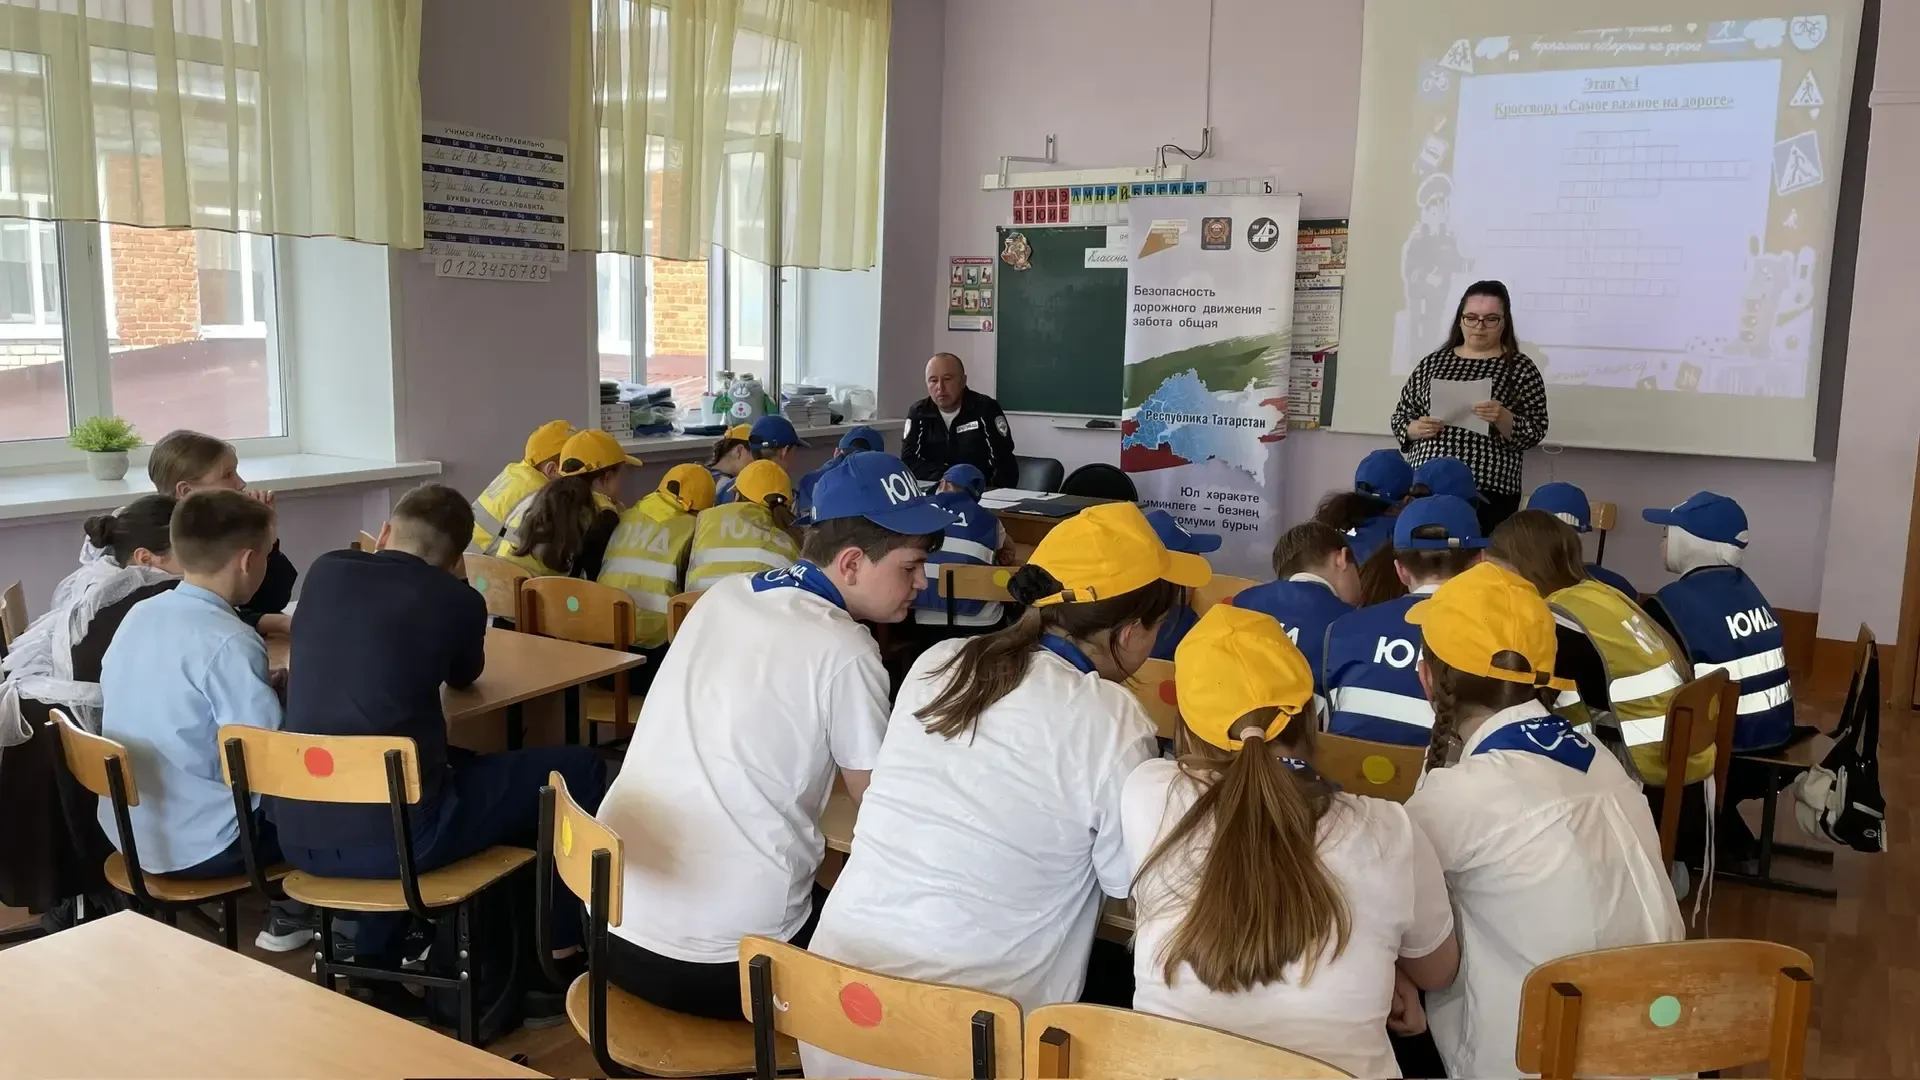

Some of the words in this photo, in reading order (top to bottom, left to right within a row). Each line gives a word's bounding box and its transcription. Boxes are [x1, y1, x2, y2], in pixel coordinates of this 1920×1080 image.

[1583, 77, 1615, 90] Этап
[1494, 102, 1558, 117] Кроссворд
[1611, 98, 1659, 110] важное
[1662, 99, 1678, 108] на
[1682, 95, 1734, 108] дороге»
[444, 127, 474, 137] УЧИМСЯ
[476, 132, 503, 142] ПИСАТЬ
[504, 137, 545, 149] ПРАВИЛЬНО
[446, 194, 471, 203] БУКВЫ
[472, 197, 507, 206] РУССКОГО
[508, 201, 545, 211] АЛФАВИТА
[1134, 285, 1216, 297] Безопасность
[1133, 303, 1197, 314] дорожного
[1202, 304, 1262, 315] движения
[1132, 317, 1173, 327] забота
[1178, 317, 1218, 329] общая
[1145, 410, 1208, 425] Республика
[1212, 414, 1266, 429] Татарстан
[880, 470, 926, 505] ЮИ
[1180, 486, 1200, 498] Юл
[1206, 490, 1259, 503] хәрәкәте
[1217, 504, 1259, 519] безнең
[1222, 518, 1259, 532] бурыч
[1725, 605, 1778, 640] ЮИД
